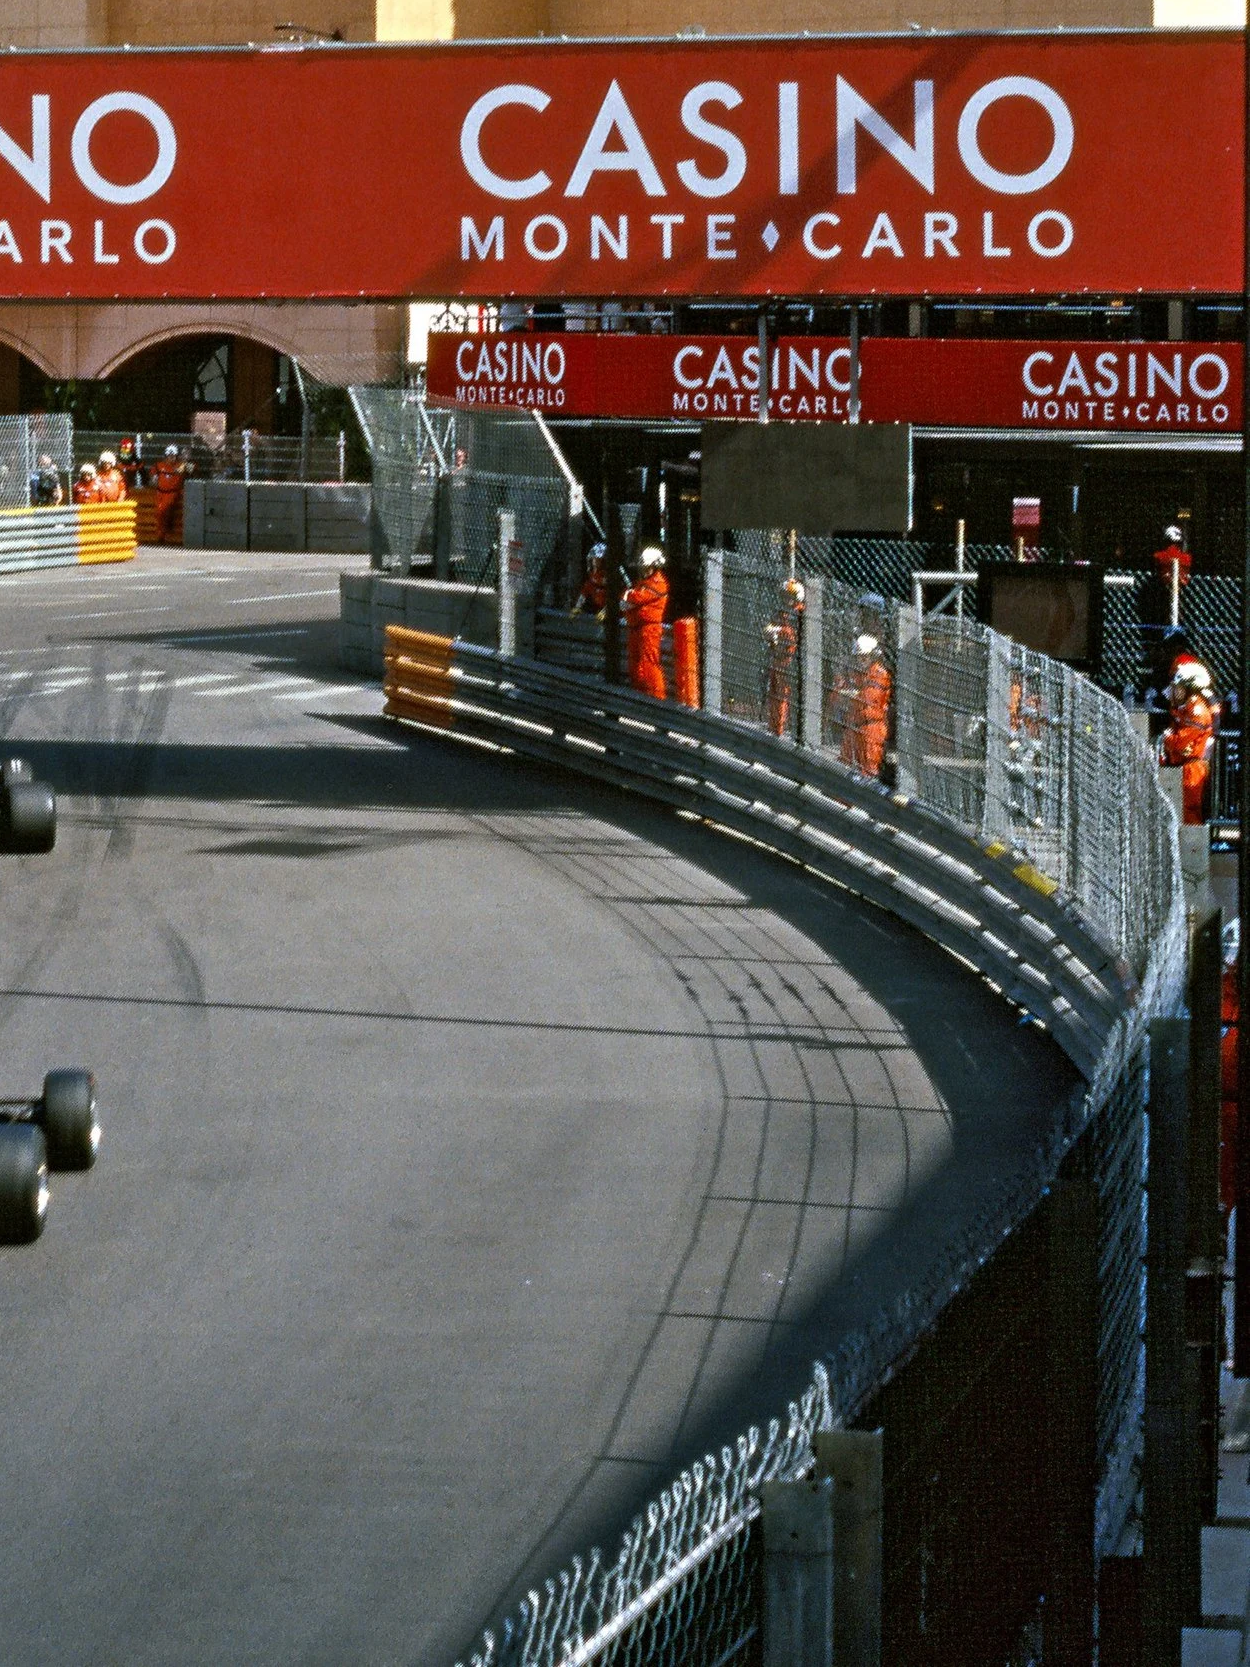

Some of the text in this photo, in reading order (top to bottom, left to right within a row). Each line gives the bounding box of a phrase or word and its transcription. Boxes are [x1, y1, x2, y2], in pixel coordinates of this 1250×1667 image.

[459, 73, 1075, 201] CASINO
[460, 209, 1074, 263] MONTE CARLO
[455, 339, 566, 385] CASINO
[672, 345, 863, 393] CASINO
[1021, 350, 1230, 400] CASINO
[456, 385, 565, 407] MONTE CARLO
[672, 392, 762, 413] MONTE
[1022, 400, 1229, 424] MONTE CARLO
